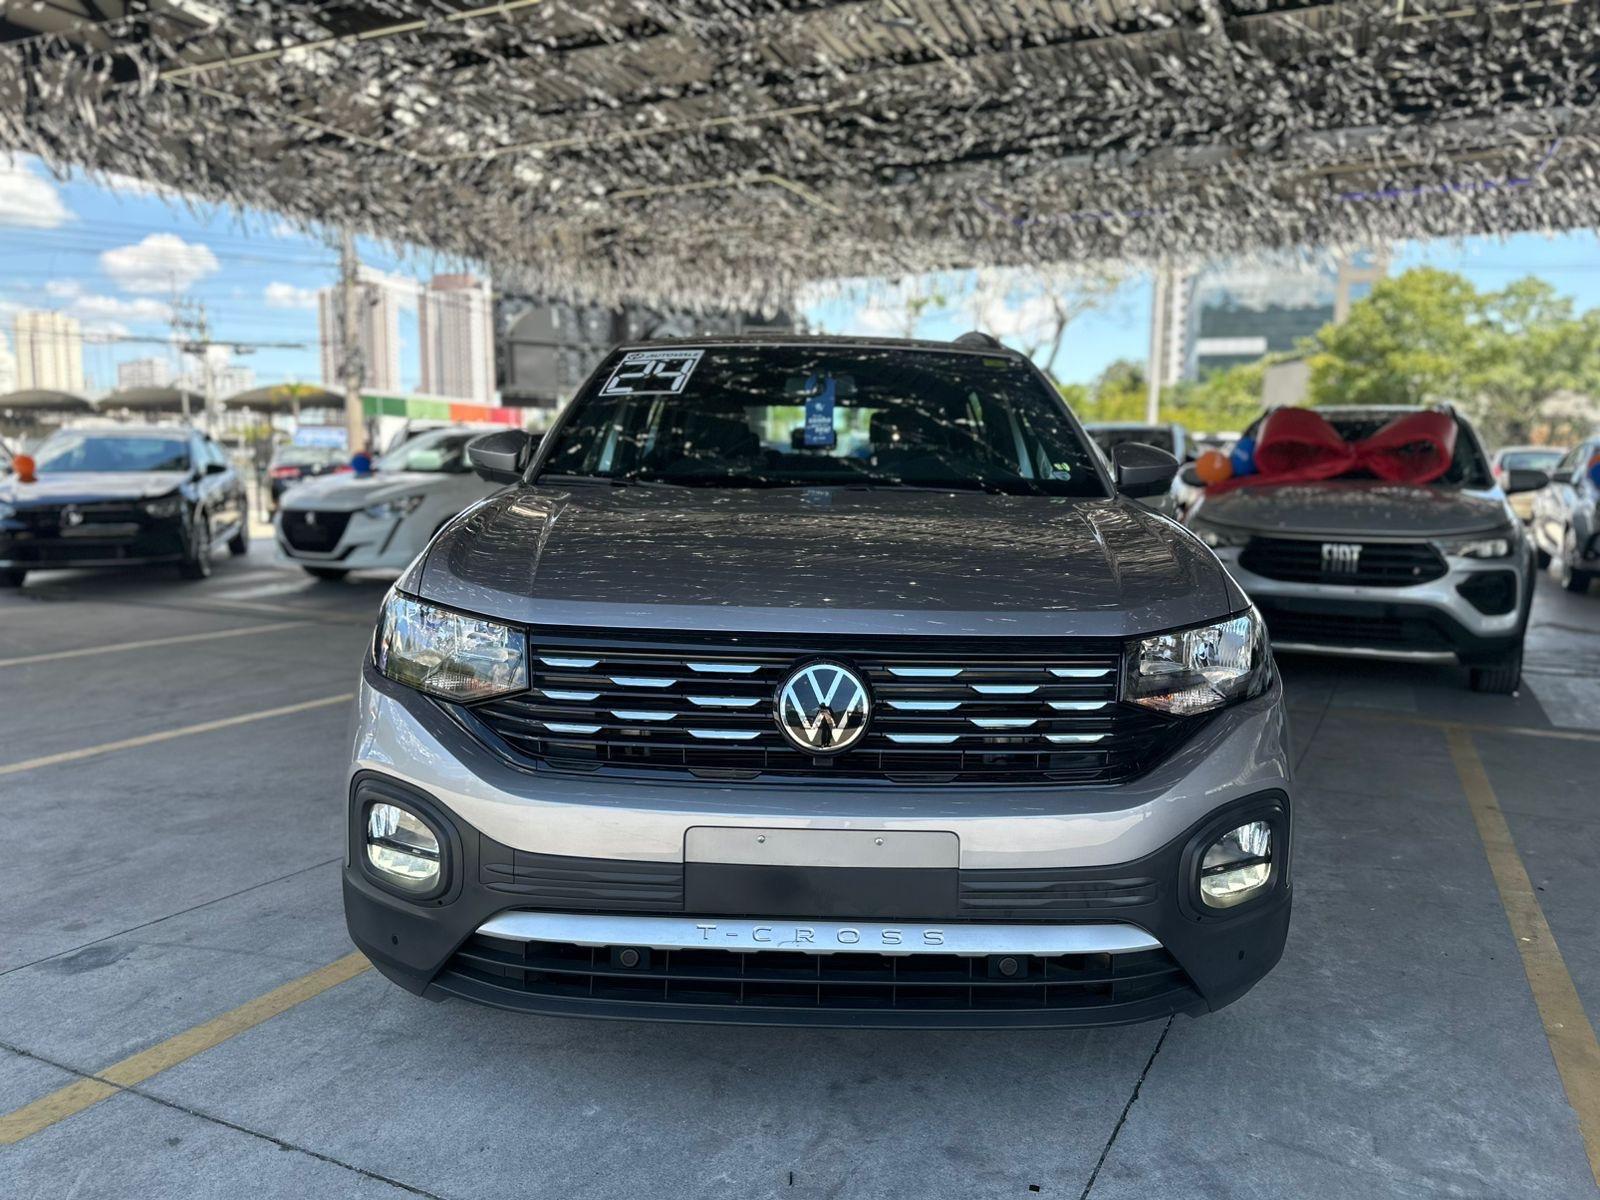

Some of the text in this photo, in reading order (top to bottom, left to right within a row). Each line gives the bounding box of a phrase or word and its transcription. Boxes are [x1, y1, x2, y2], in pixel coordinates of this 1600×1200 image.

[606, 359, 693, 393] 24
[1321, 543, 1363, 573] FIAT
[696, 924, 945, 946] T-CROSS
